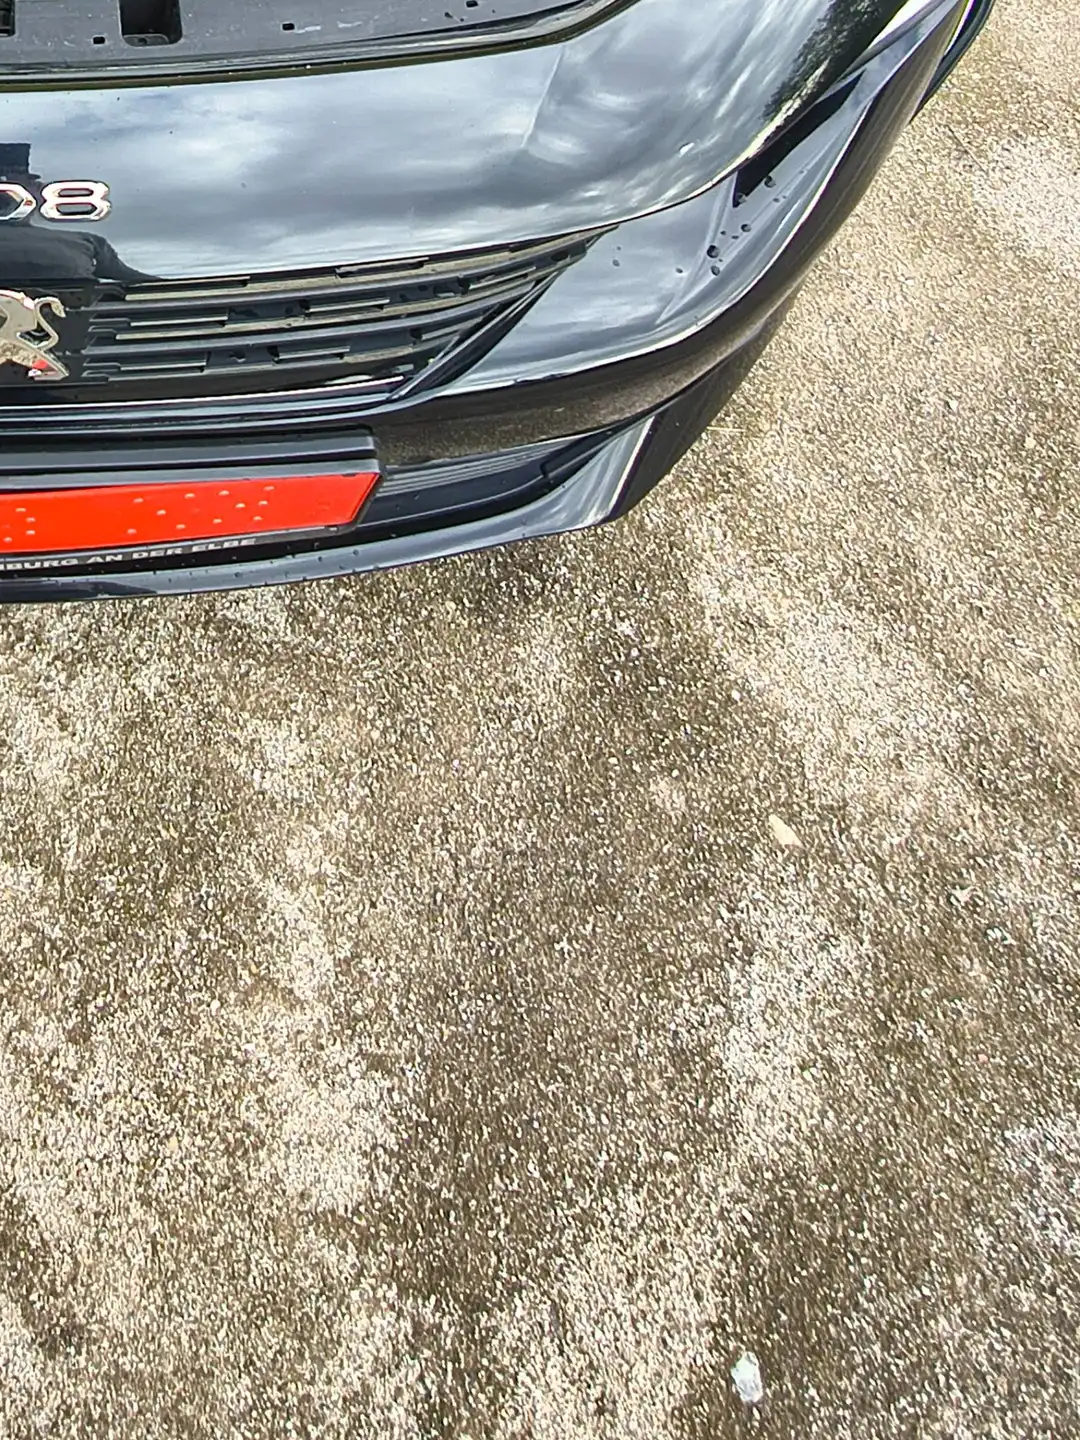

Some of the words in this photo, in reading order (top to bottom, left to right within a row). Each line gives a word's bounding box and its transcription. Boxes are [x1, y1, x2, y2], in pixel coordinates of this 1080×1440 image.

[85, 553, 123, 564] AN
[132, 545, 183, 559] DER
[191, 537, 257, 553] ELBE
